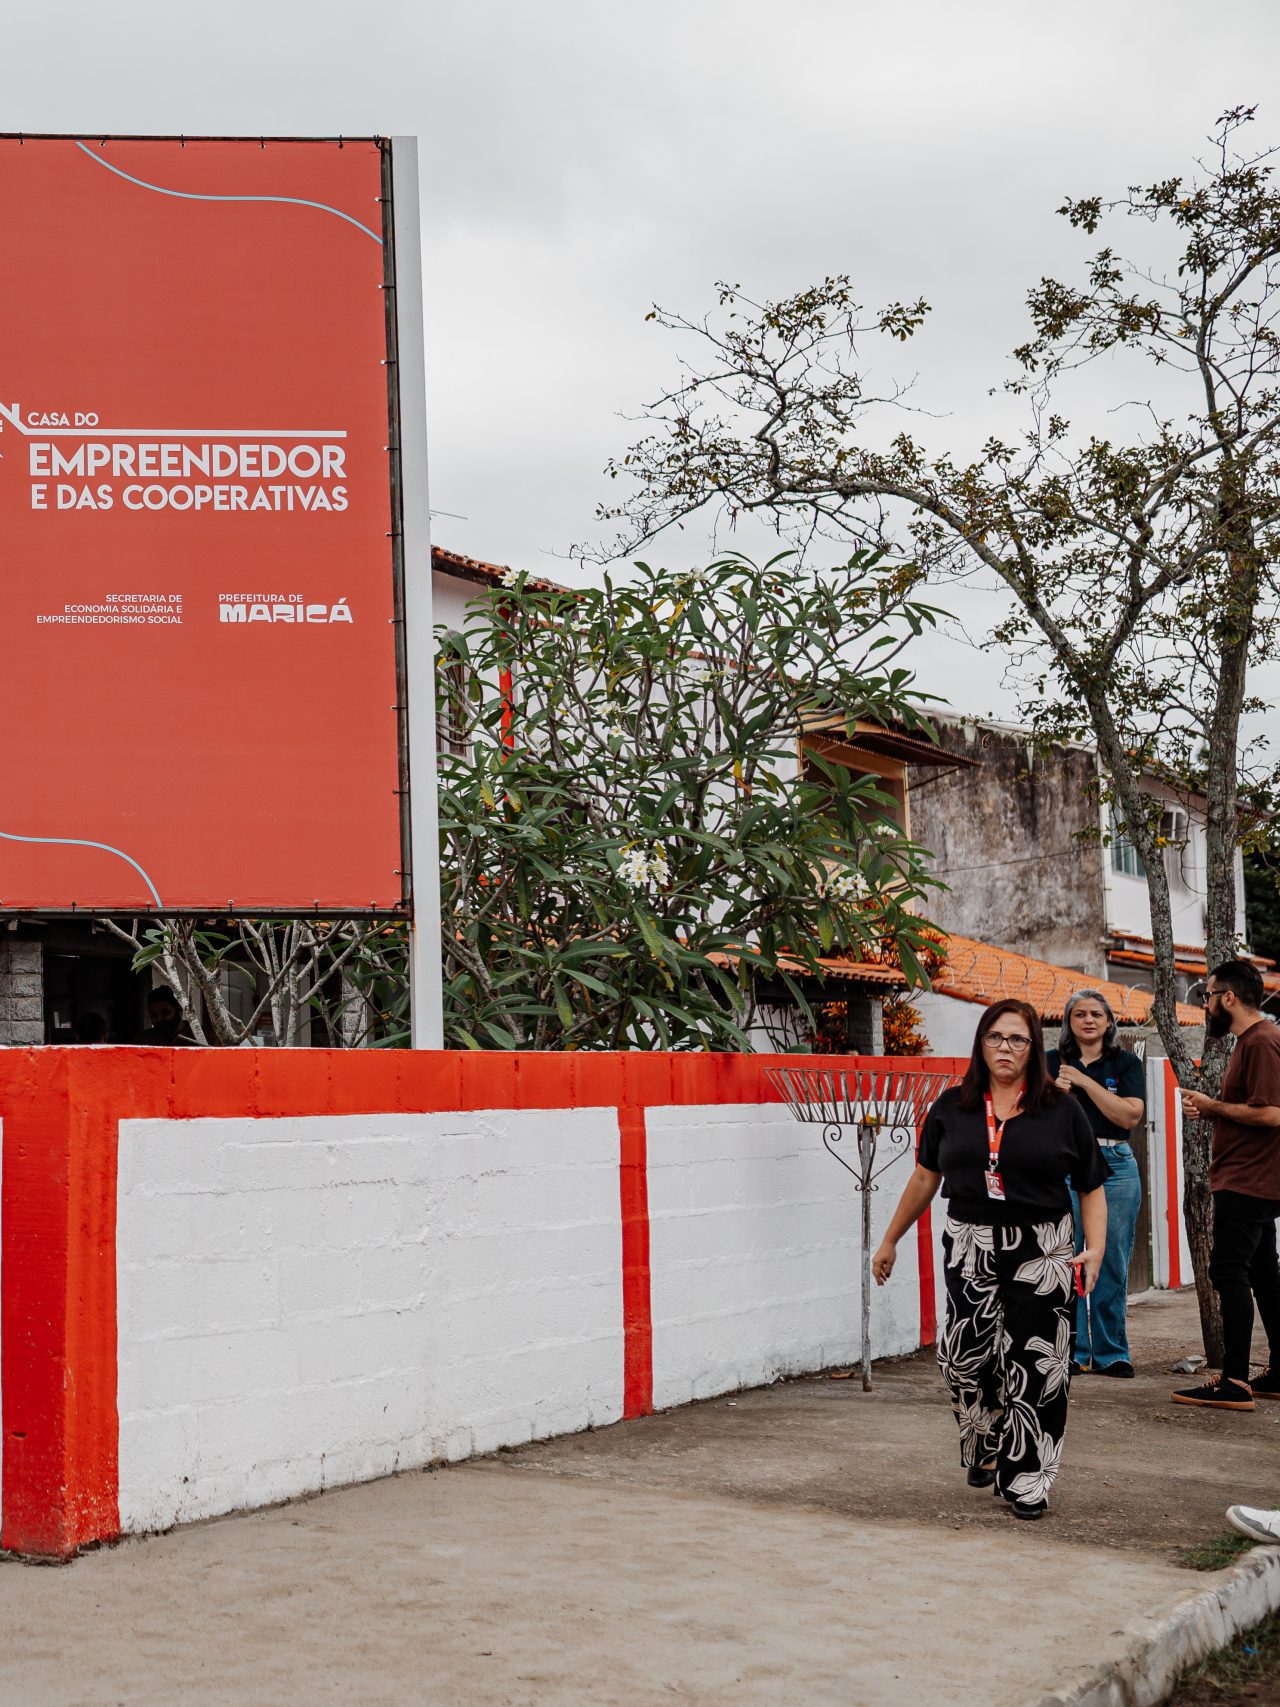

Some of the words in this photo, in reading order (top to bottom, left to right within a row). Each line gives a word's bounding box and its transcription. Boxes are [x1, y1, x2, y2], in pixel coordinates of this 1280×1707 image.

[27, 411, 71, 427] CASA
[74, 412, 100, 427] DO
[29, 442, 348, 479] EMPREENDEDOR
[31, 483, 48, 510] E
[56, 483, 114, 510] DAS
[122, 484, 349, 512] COOPERATIVAS
[105, 594, 167, 603] SECRETARIA
[168, 594, 183, 603] DE
[218, 593, 286, 603] PREFEITURA
[288, 594, 304, 603] DE
[64, 604, 119, 613] ECONOMIA
[121, 603, 174, 614] SOLIDÁRIA
[176, 605, 183, 614] E
[219, 597, 354, 624] MARICÁ
[36, 615, 146, 624] EMPREENDEDORISMO
[147, 615, 184, 624] SOCIAL
